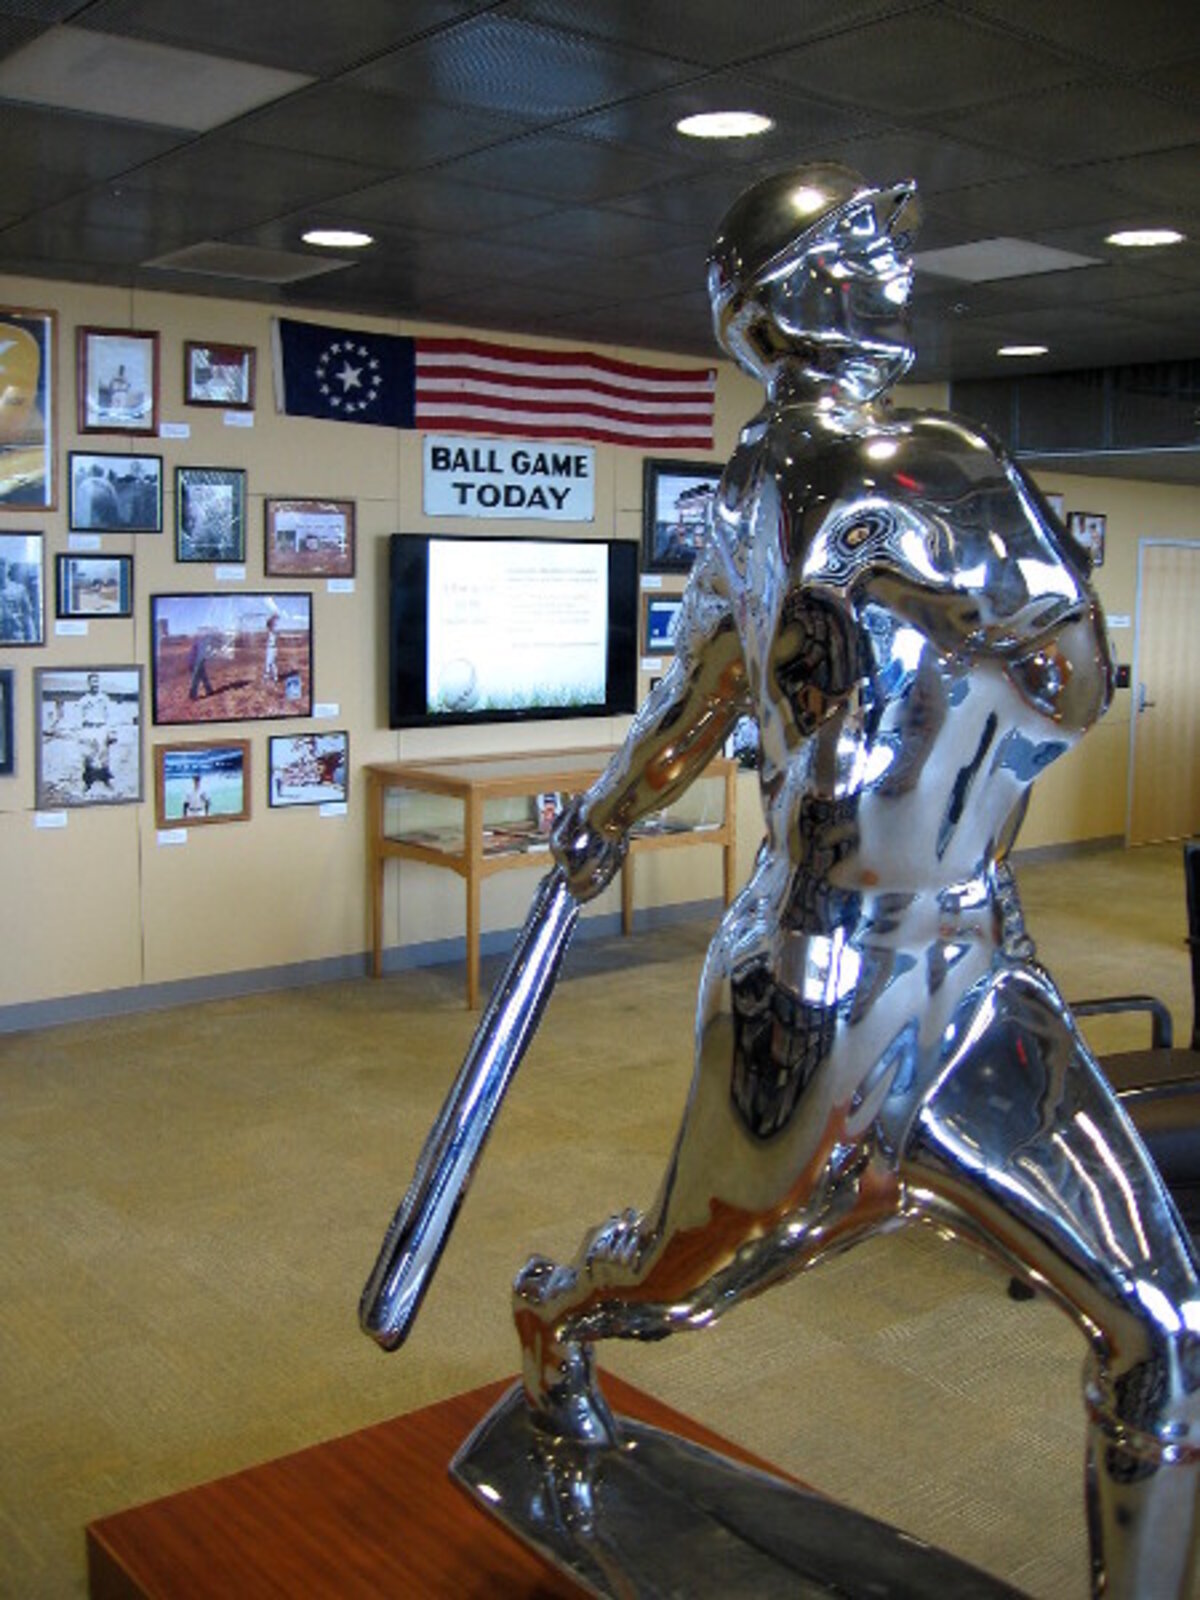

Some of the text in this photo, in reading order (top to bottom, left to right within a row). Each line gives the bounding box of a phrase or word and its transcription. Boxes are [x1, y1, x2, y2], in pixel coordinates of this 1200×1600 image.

[431, 446, 588, 478] BALL GAME
[452, 482, 572, 510] TODAY
